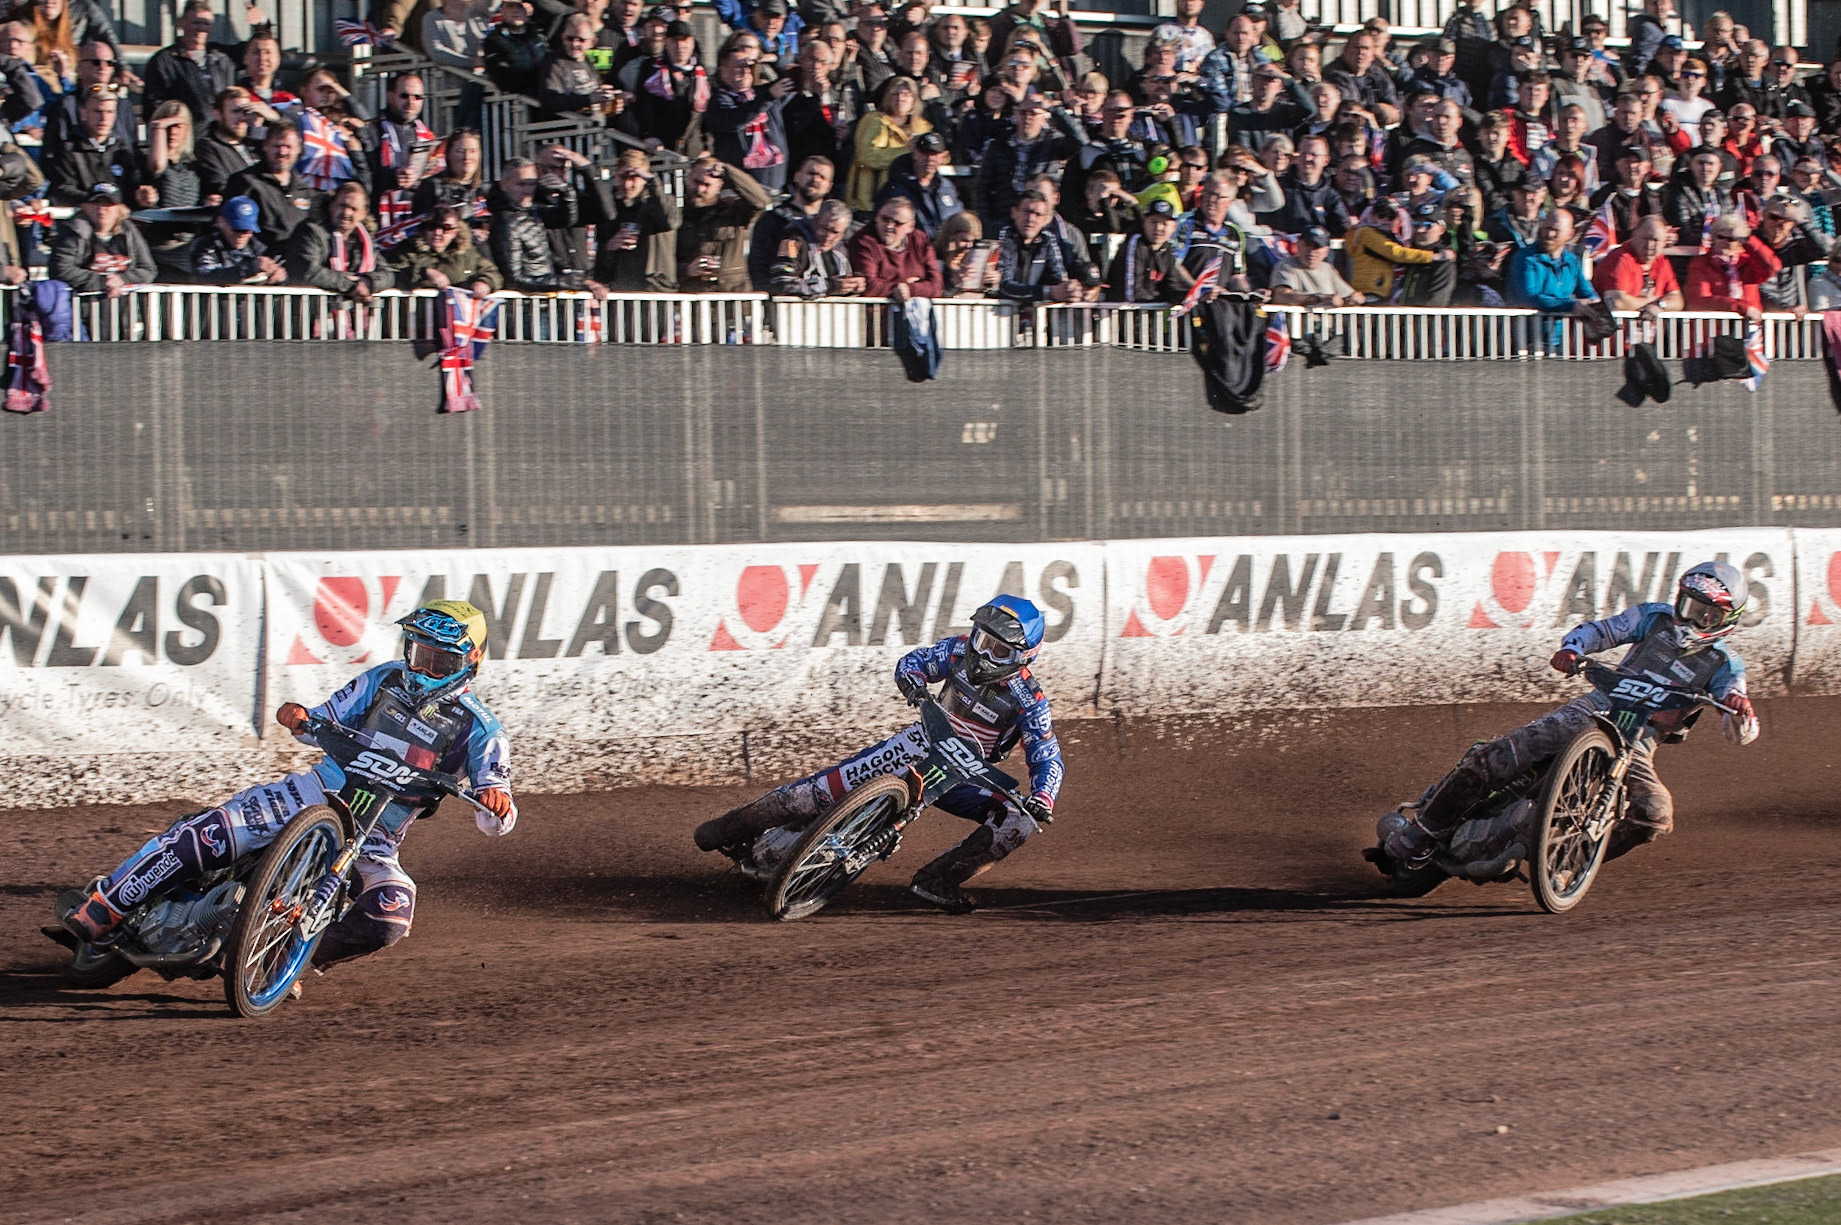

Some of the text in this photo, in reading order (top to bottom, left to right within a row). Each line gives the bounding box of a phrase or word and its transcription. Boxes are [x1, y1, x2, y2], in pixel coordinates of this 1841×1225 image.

[1205, 551, 1443, 634] ANLAS
[463, 696, 493, 723] MOTUL
[845, 742, 906, 781] HAGON
[850, 752, 913, 789] SHOCKS
